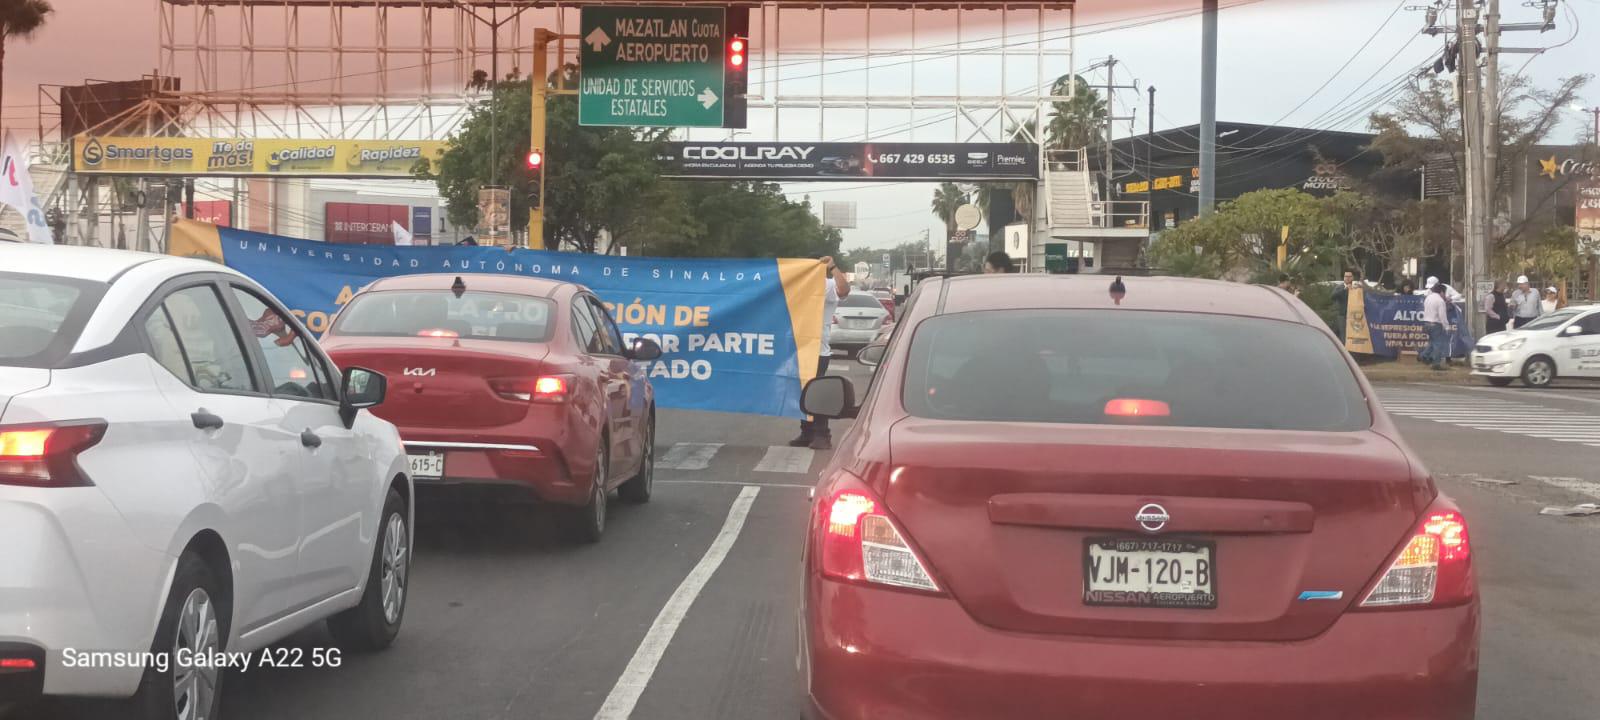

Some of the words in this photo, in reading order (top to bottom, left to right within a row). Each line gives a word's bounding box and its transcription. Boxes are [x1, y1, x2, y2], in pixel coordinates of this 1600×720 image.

[615, 18, 688, 38] MAZATLAN
[615, 43, 709, 63] AEROPUERTO
[583, 78, 621, 95] UNIDAD
[624, 79, 638, 96] DE
[641, 79, 695, 97] SERVICIOS
[611, 99, 668, 117] ESTATALES
[106, 144, 194, 162] Smartgas
[235, 141, 253, 152] da
[278, 145, 336, 161] Calidad
[360, 146, 421, 164] Rapidez
[682, 146, 816, 160] COOLRAY
[879, 154, 901, 164] 667
[903, 154, 925, 164] 429
[927, 154, 956, 164] 6535
[240, 240, 419, 268] UNIVERSIDAD
[603, 267, 630, 278] DE
[652, 269, 763, 282] SINALOA
[674, 305, 711, 328] DE
[1393, 310, 1425, 322] ALTO
[688, 333, 775, 355] PARTE
[634, 359, 712, 381] TADO
[1142, 543, 1182, 552] 717-1717
[1089, 555, 1209, 587] VJM-120-B
[1086, 591, 1151, 603] NISSAN
[1153, 592, 1215, 602] AEROPUERTO
